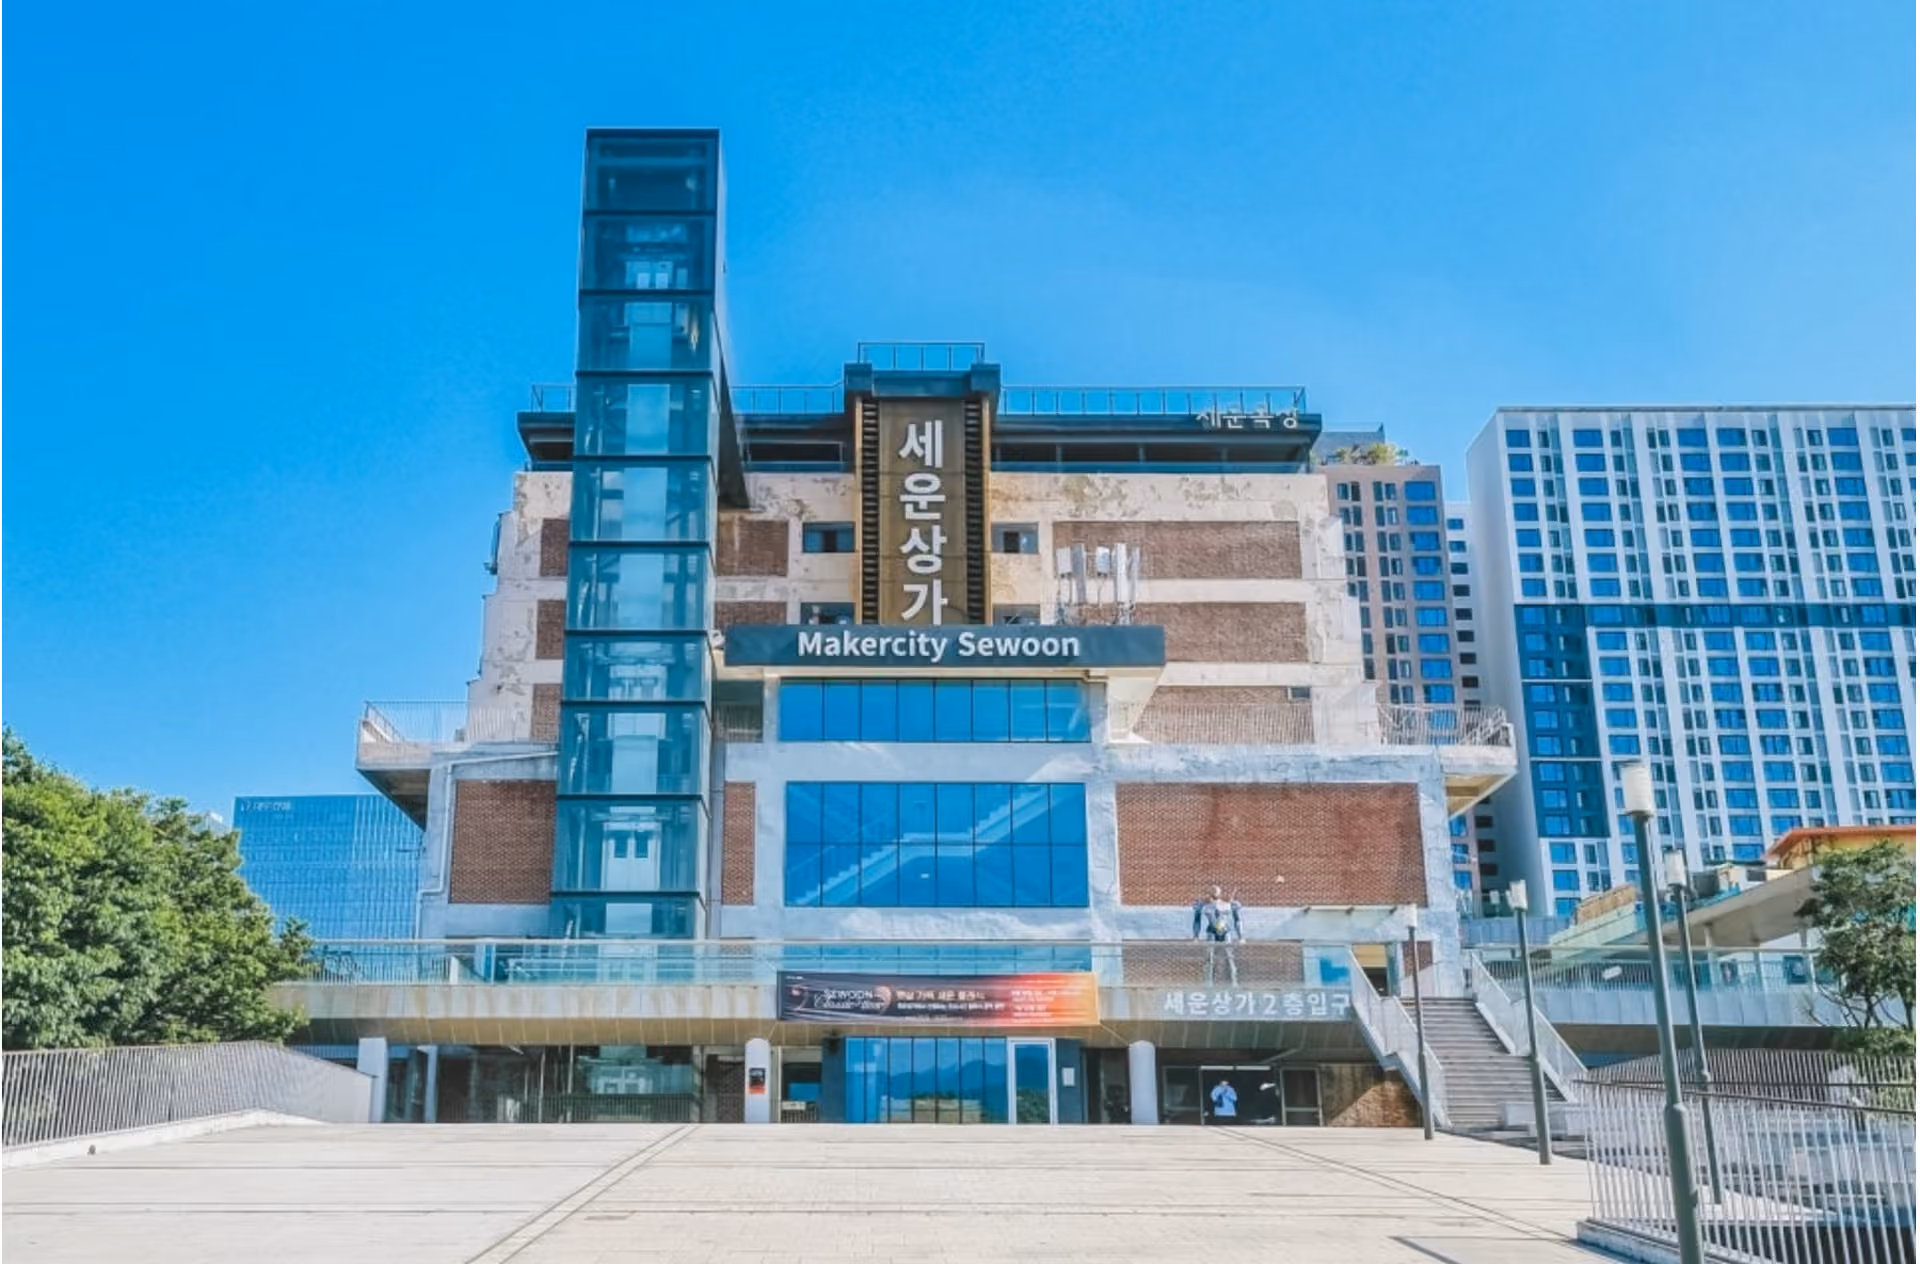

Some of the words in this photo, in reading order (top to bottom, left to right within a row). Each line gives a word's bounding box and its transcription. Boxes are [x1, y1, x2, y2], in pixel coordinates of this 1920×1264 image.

[898, 419, 948, 625] 세운상가
[798, 630, 947, 663] Makercity
[958, 630, 1080, 657] Sewoon
